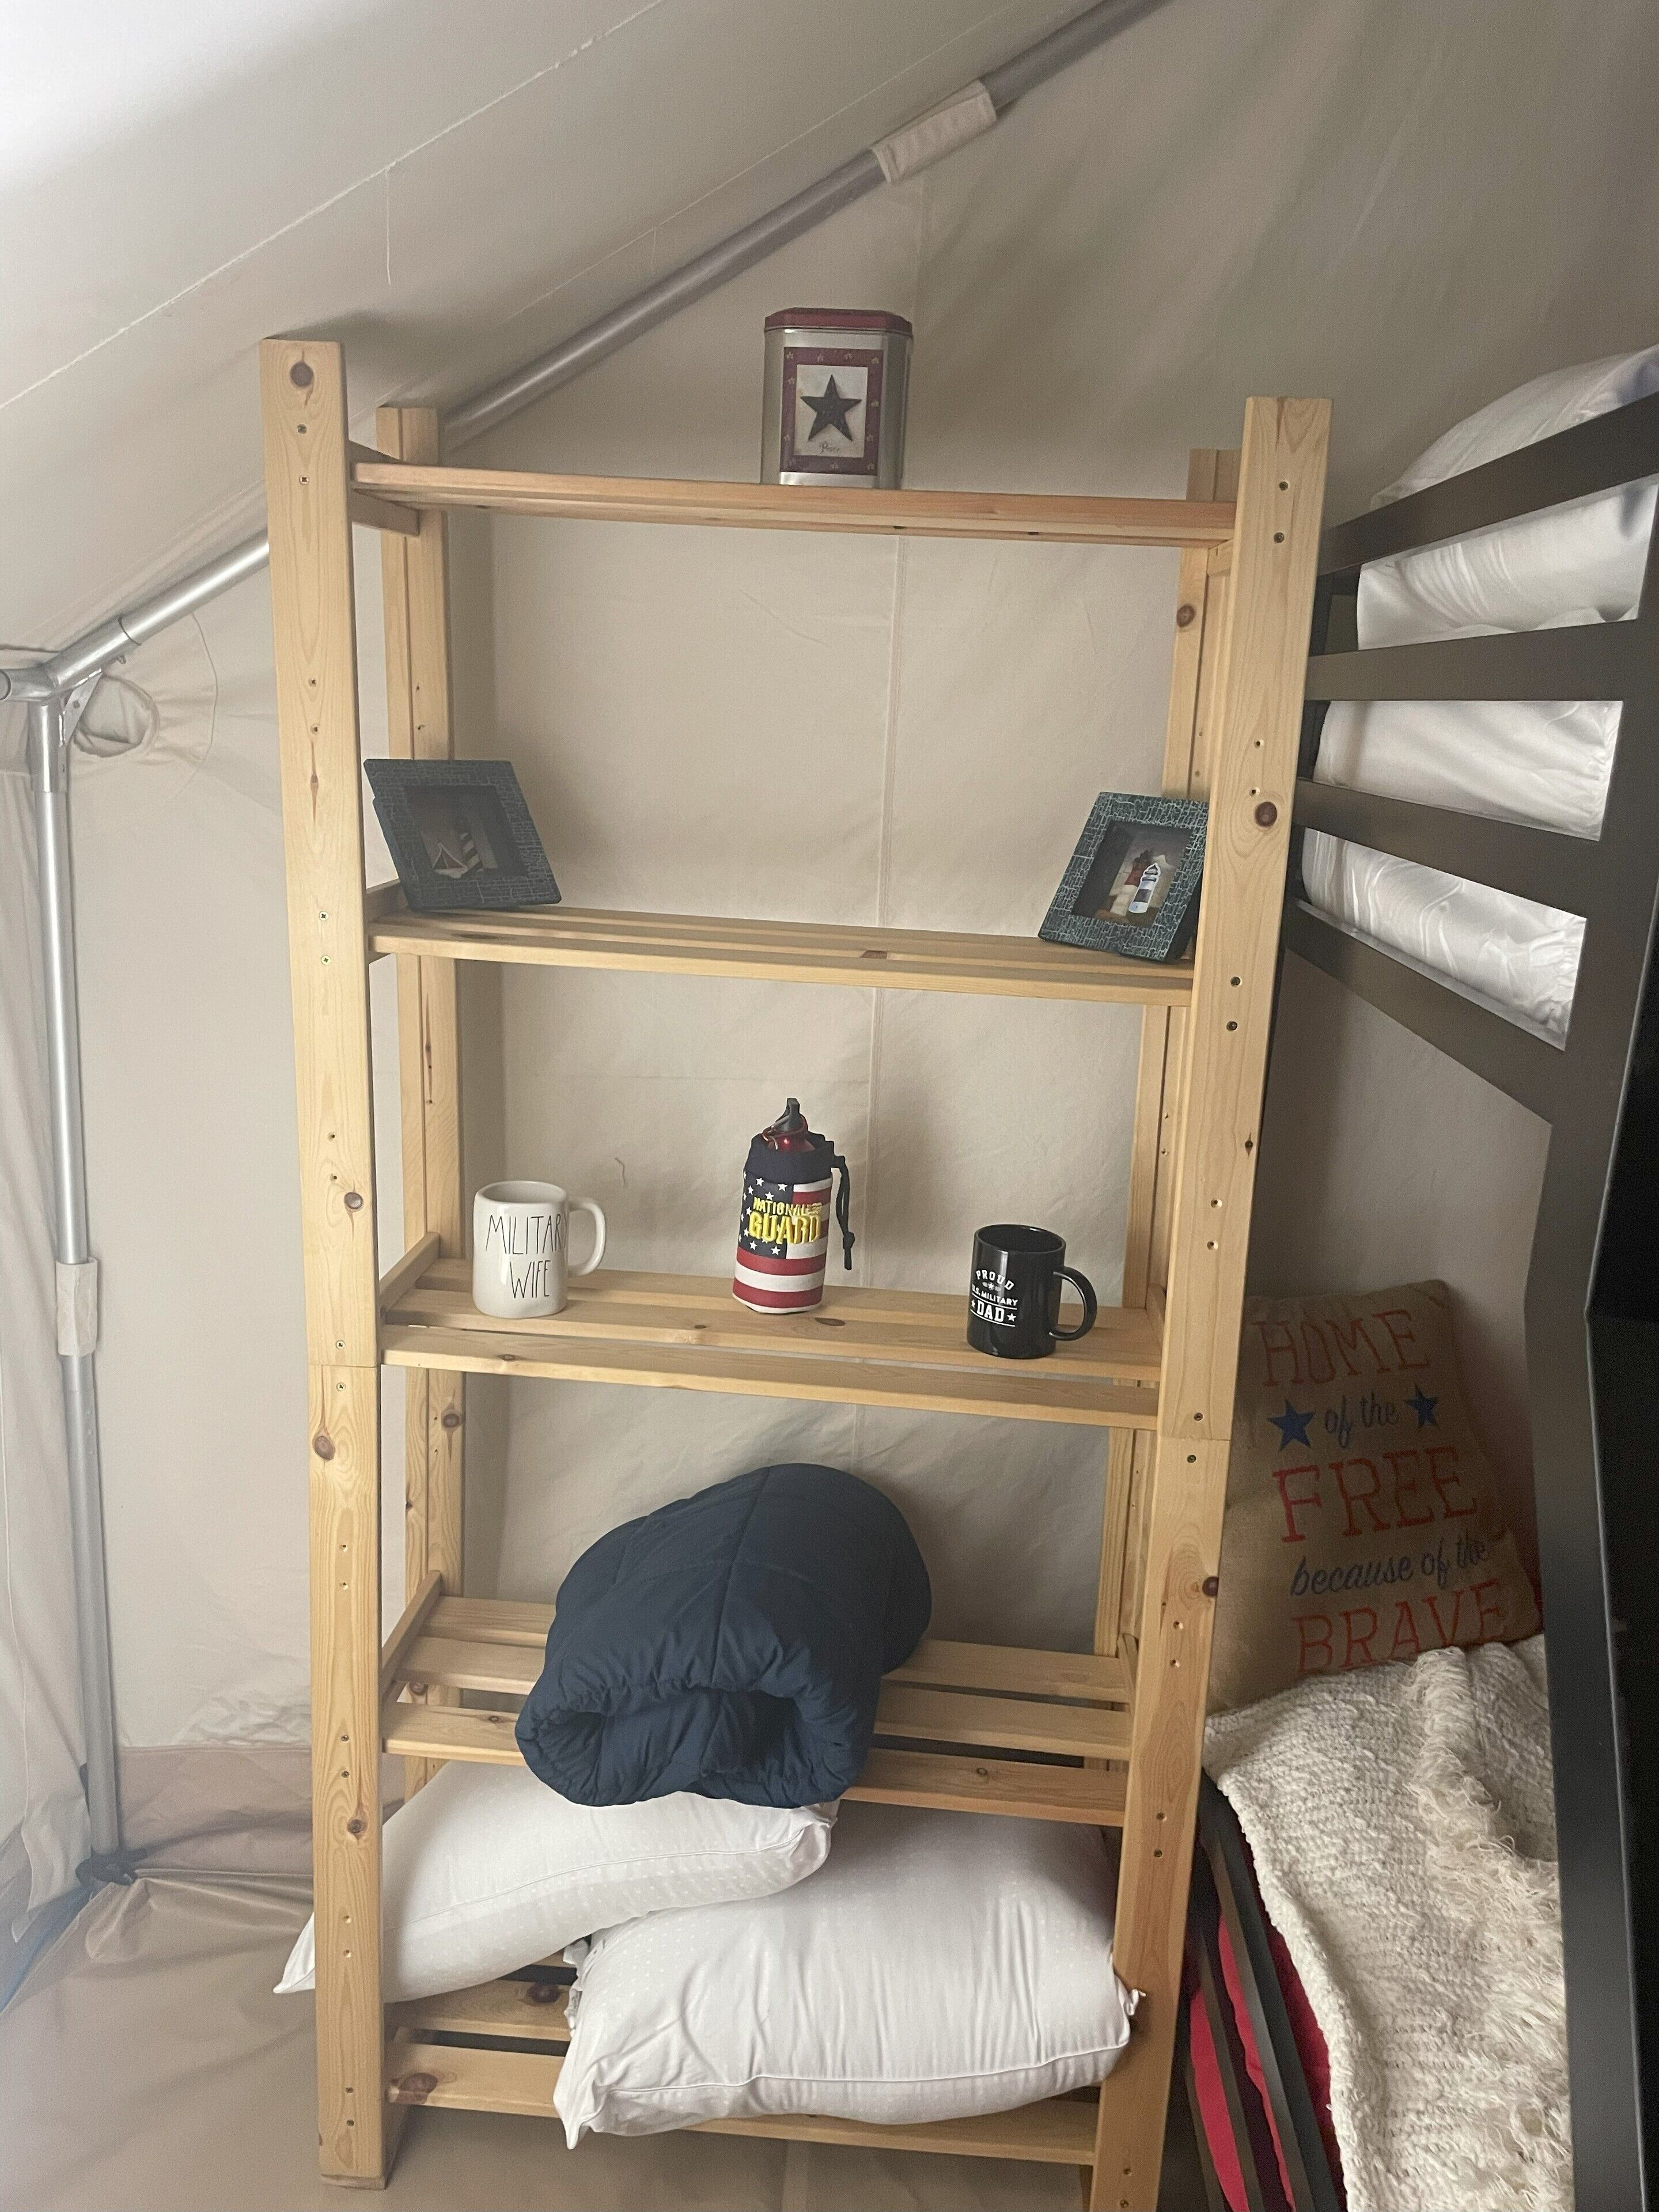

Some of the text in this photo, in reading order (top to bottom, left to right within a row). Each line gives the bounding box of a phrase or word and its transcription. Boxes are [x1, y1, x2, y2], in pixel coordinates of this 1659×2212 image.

[753, 1196, 808, 1216] NATIONAL
[748, 1210, 820, 1245] GUARD
[509, 1260, 551, 1298] WIFE
[976, 1270, 1014, 1290] PROUD
[981, 1290, 1018, 1306] MILITARY
[976, 1300, 1005, 1322] DAD
[1252, 1309, 1430, 1387] HOME
[1324, 1391, 1400, 1448] of the
[1272, 1446, 1478, 1543] FREE
[1290, 1528, 1490, 1596] because of the
[1293, 1578, 1509, 1673] BRAVE
